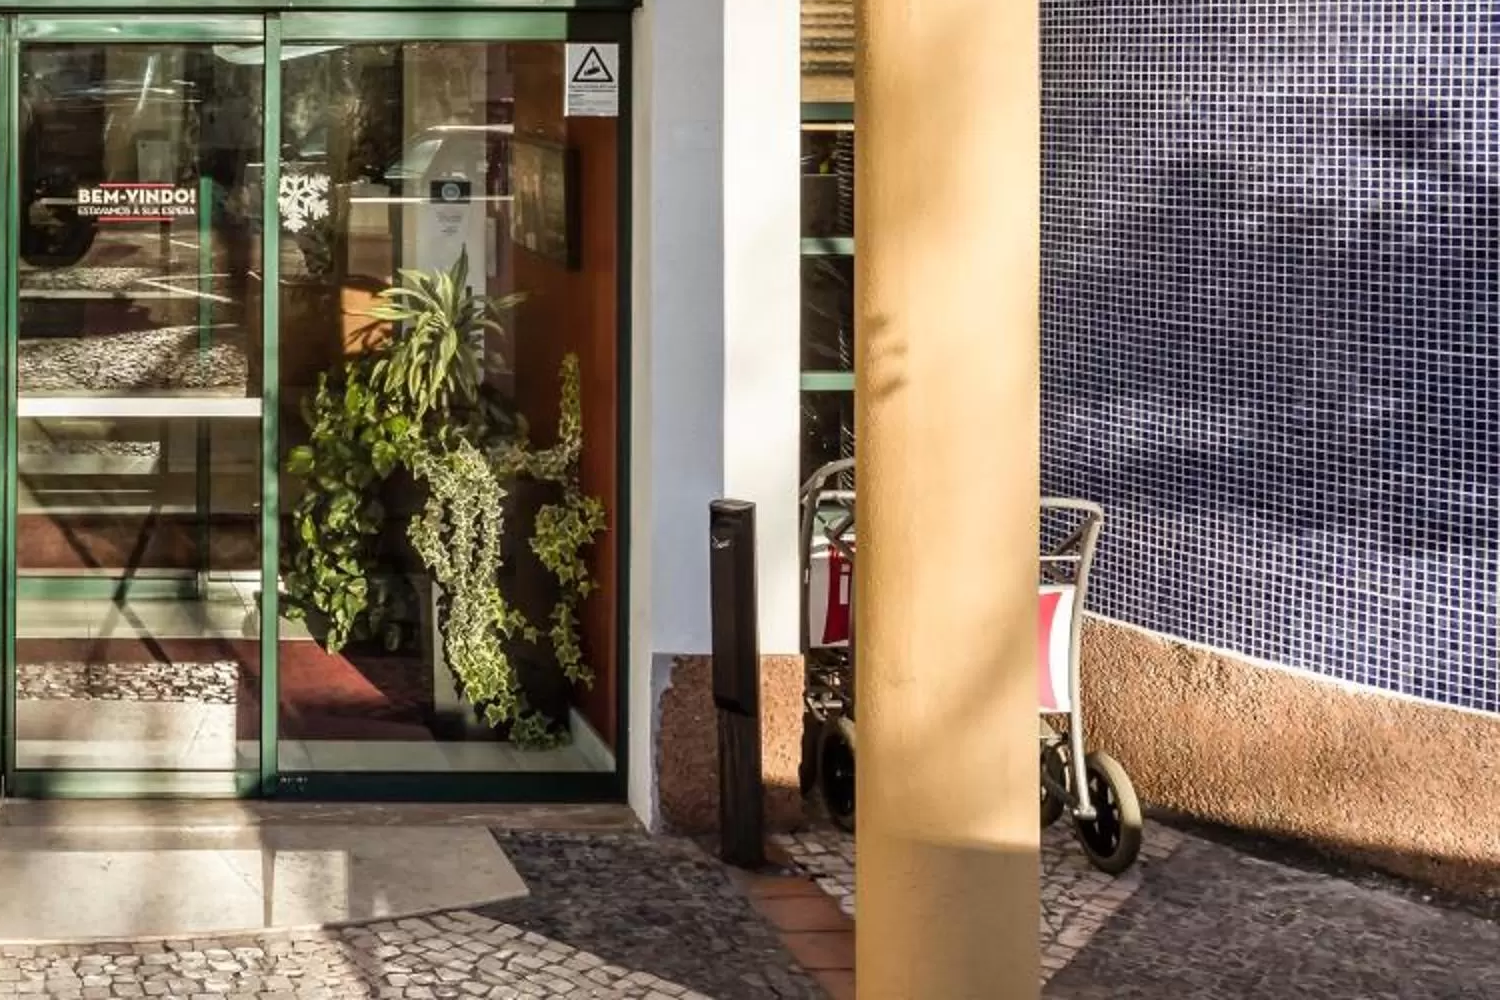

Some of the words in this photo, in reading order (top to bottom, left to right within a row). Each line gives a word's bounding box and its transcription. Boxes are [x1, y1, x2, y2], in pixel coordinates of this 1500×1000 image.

[77, 188, 196, 204] BEM-VINDO!
[142, 206, 160, 216] SUA
[161, 206, 196, 216] ESPERA
